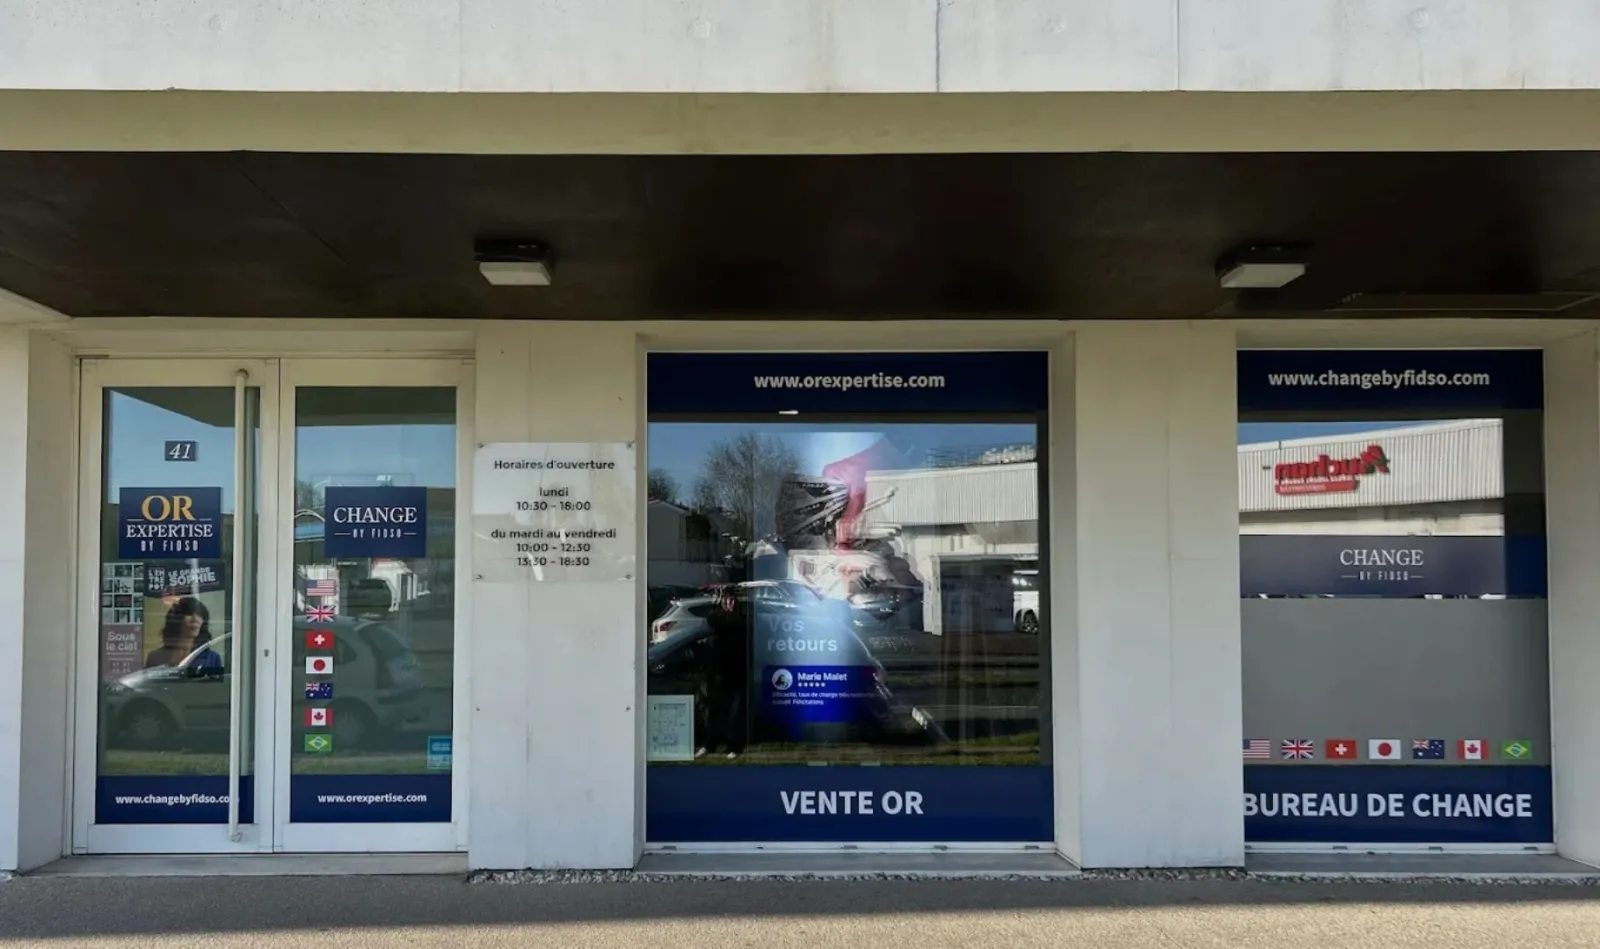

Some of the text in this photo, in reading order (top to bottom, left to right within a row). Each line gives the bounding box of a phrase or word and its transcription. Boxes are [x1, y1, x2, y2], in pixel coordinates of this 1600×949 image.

[754, 372, 946, 391] www.orexpertise.com
[1268, 369, 1491, 389] www.changebyfidso.com
[169, 443, 191, 459] 41
[494, 459, 615, 470] Horaires d'ouverture
[539, 487, 569, 497] lundi
[141, 495, 196, 521] OR
[516, 501, 548, 511] 10:30
[560, 501, 591, 511] 18:00
[333, 506, 418, 524] CHANGE
[126, 524, 213, 538] EXPERTISE
[490, 527, 617, 539] du mardi au vendredi
[140, 540, 199, 552] BY FIDSO
[516, 543, 549, 552] 10:00
[561, 543, 591, 552] 12:30
[517, 557, 547, 566] 13:30
[560, 556, 590, 566] 18:30
[1339, 549, 1424, 566] CHANGE
[169, 571, 217, 587] SOPHIE
[767, 636, 838, 652] retours
[797, 672, 847, 681] Marie Malet
[115, 794, 229, 806] www.changebyfidso.co
[318, 793, 427, 804] www.orexpertise.com
[780, 791, 924, 815] VENTE OR
[1243, 793, 1533, 818] BUREAU DE CHANGE
